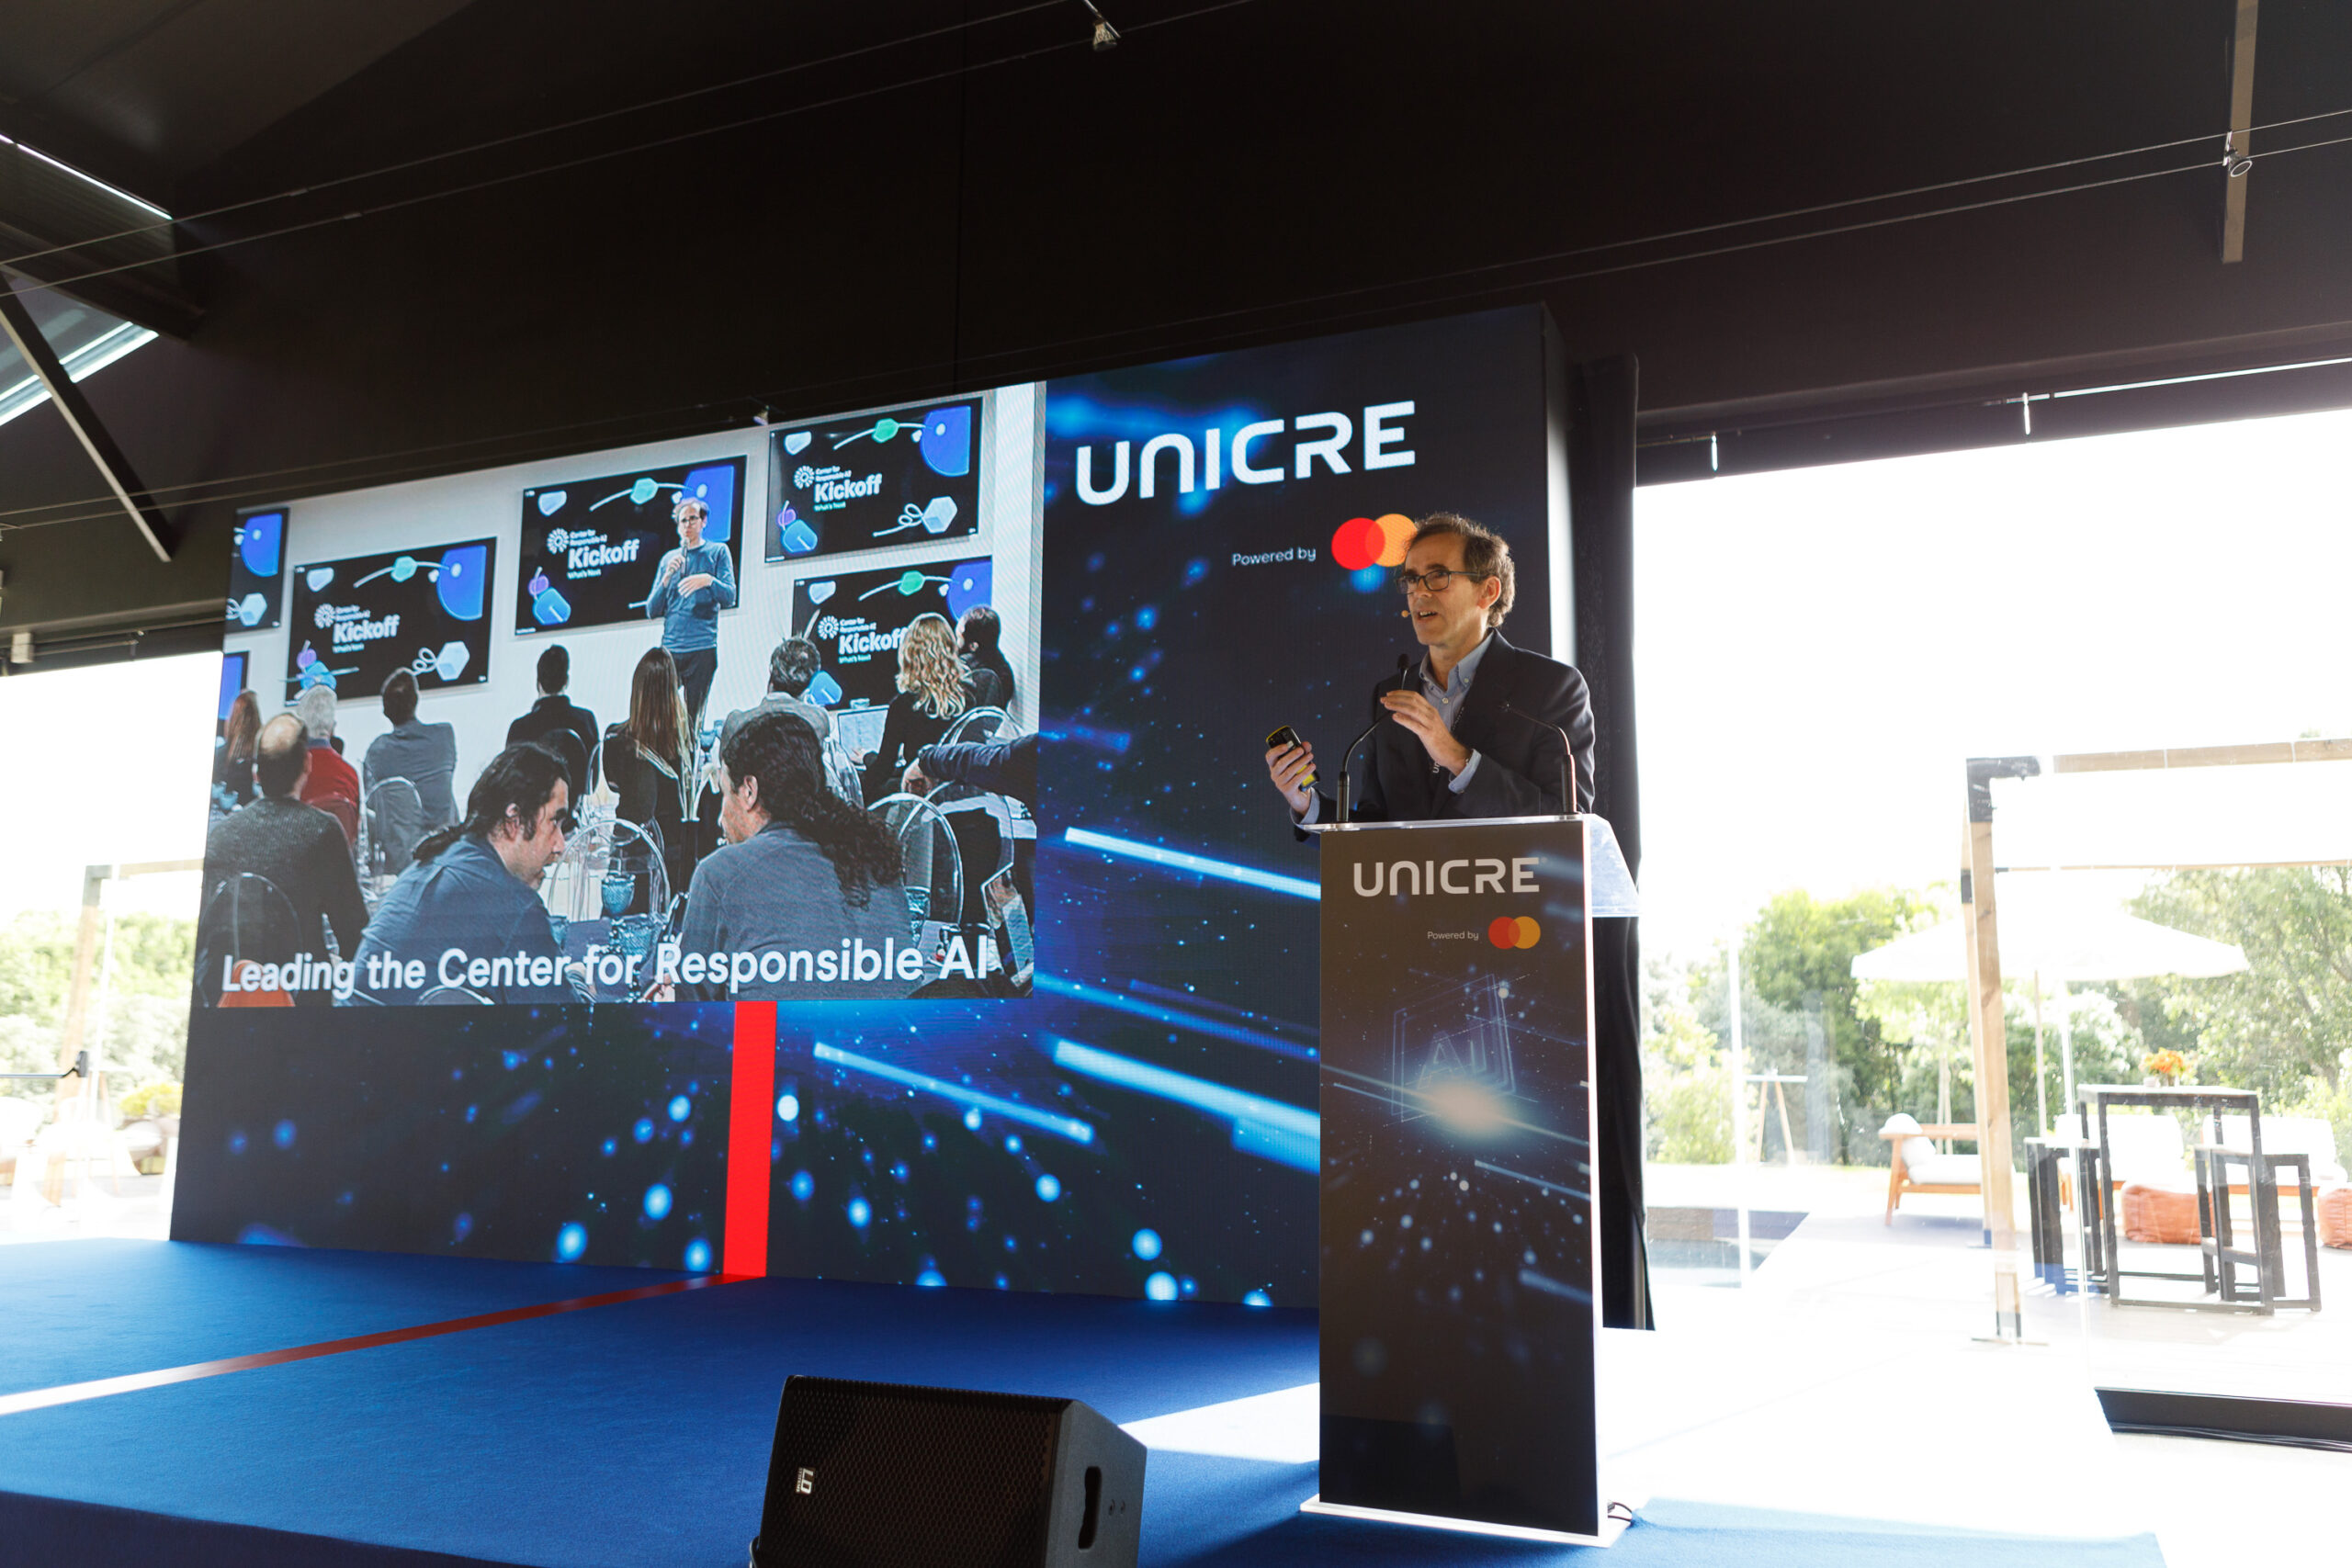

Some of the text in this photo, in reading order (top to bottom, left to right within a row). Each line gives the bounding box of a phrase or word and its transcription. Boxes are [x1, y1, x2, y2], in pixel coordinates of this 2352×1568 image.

[1076, 400, 1416, 506] UNICRE
[814, 472, 883, 503] Kickoff
[568, 538, 640, 570] Kickoff
[1232, 547, 1317, 566] Powered by
[333, 613, 401, 644] Kickoff
[1352, 857, 1541, 897] UNICRE
[1427, 931, 1479, 941] Powered by
[221, 934, 989, 1000] Leading the Center for Responsible AI
[801, 1468, 814, 1495] LD
